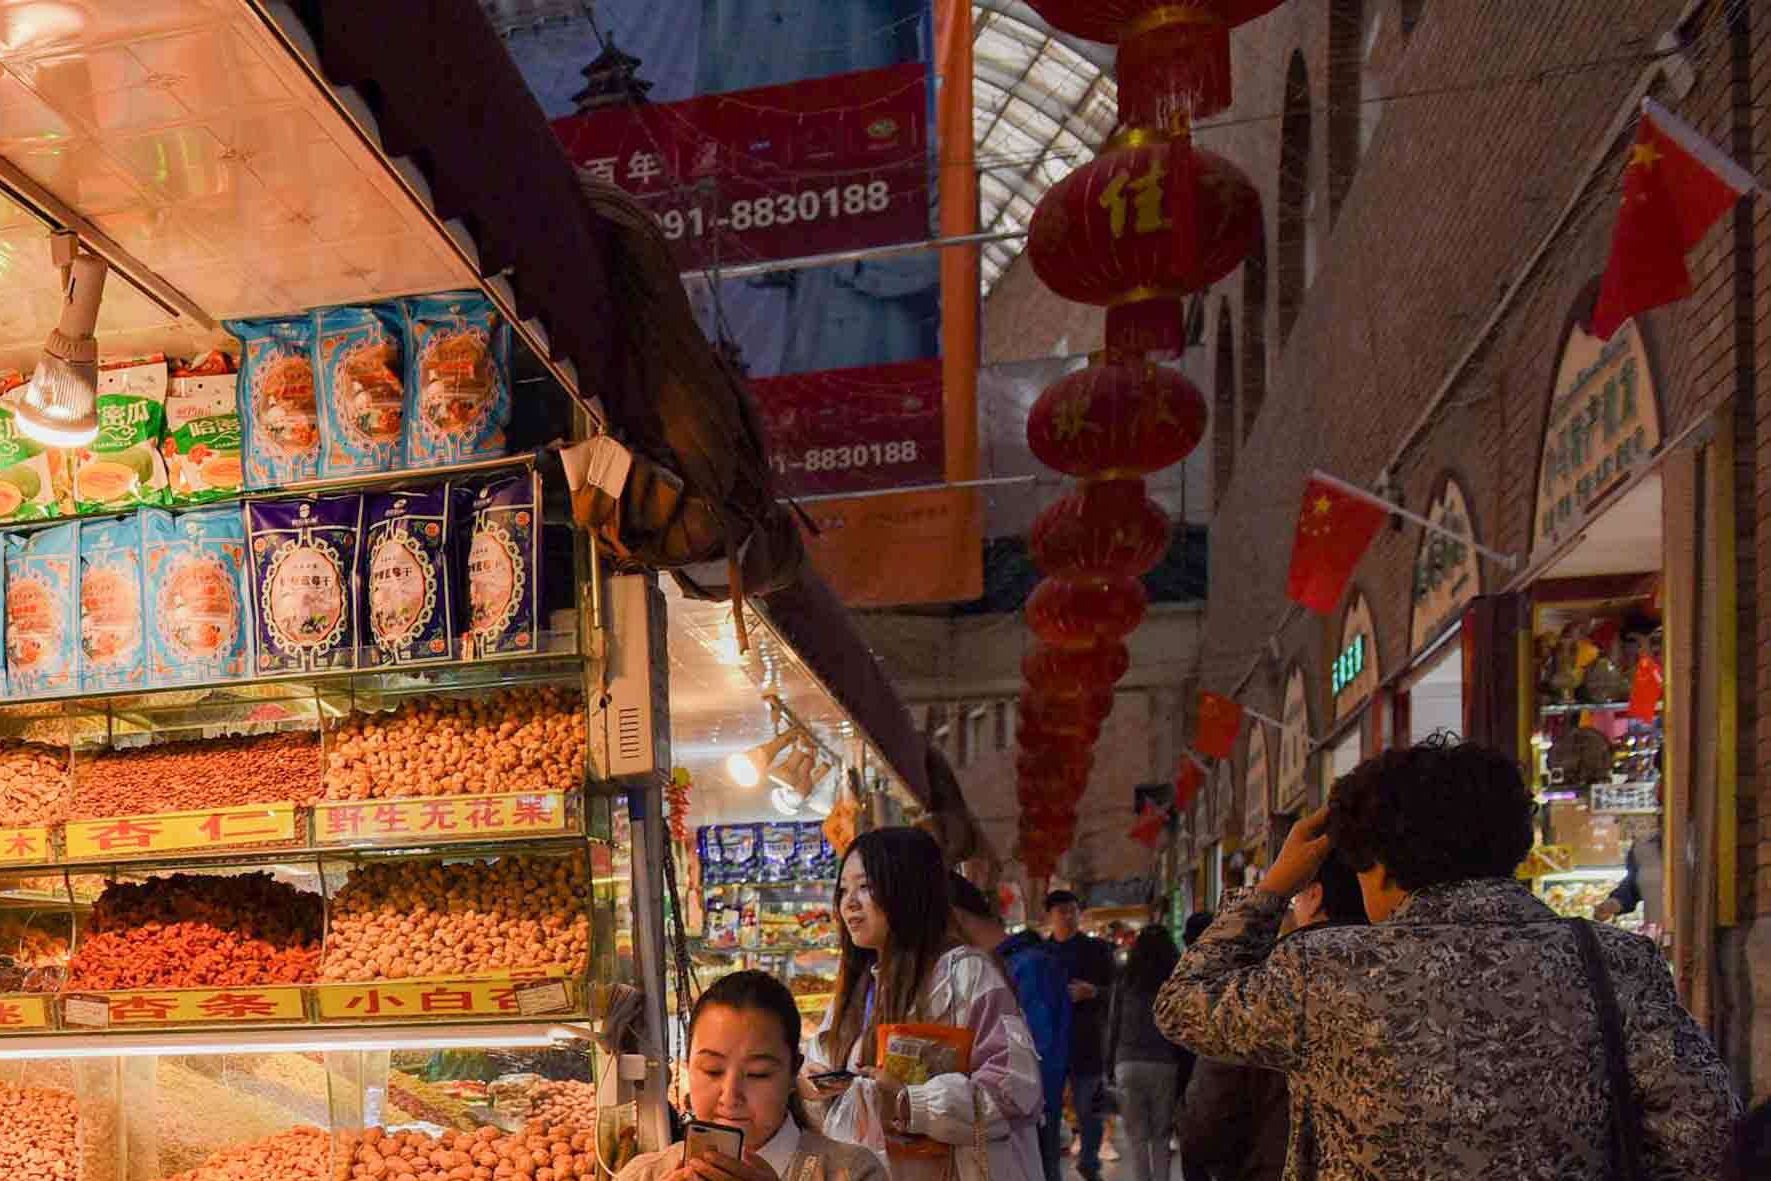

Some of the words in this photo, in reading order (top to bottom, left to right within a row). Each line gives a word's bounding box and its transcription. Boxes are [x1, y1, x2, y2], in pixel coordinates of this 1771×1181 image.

[655, 181, 890, 240] 91-8830188
[768, 440, 917, 474] 1-8830188
[87, 812, 280, 851] 杏仁
[326, 795, 554, 835] 野生无花果
[108, 992, 281, 1021] 杏条
